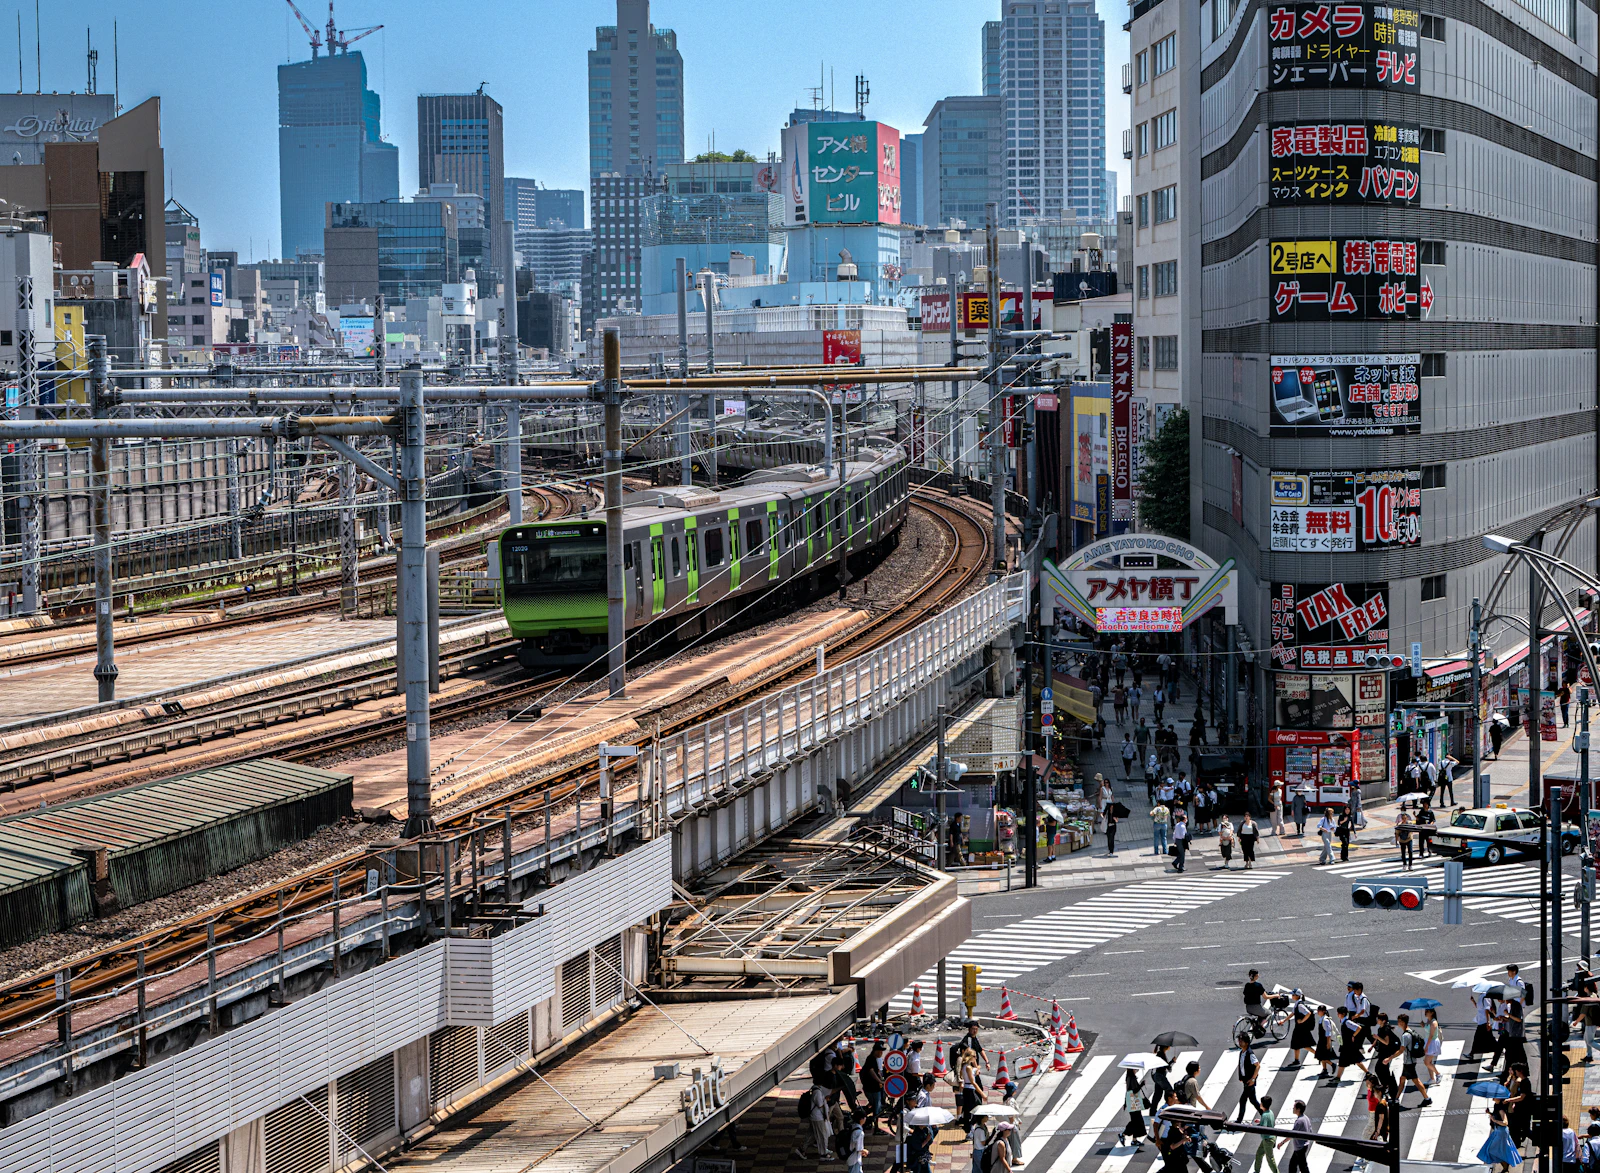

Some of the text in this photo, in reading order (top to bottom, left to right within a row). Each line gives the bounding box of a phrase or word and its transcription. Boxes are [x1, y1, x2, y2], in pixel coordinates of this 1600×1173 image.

[1270, 5, 1364, 40] カメラ
[1394, 8, 1418, 27] 修理受付
[1374, 22, 1396, 44] 時計
[1307, 44, 1370, 59] ドライヤー
[1273, 60, 1366, 84] シェーバー
[1376, 50, 1416, 85] テレビ
[1272, 125, 1368, 158] 家電製品
[1374, 125, 1397, 142] 冷蔵庫
[817, 134, 868, 154] アメ横
[1374, 146, 1401, 160] エアコン
[812, 166, 874, 183] センター
[1272, 165, 1349, 182] スーツケース
[1358, 164, 1419, 200] パソコン
[1272, 186, 1301, 198] マウス
[1305, 182, 1348, 198] インク
[826, 193, 860, 212] ビル
[1273, 245, 1332, 272] 2号店へ
[1344, 240, 1417, 276] 携帯電話
[1274, 281, 1358, 314] ゲーム
[1379, 282, 1417, 314] ホビー
[922, 301, 950, 324] サンドラッグ
[971, 301, 988, 320] 薬
[1114, 334, 1130, 403] カラオケ
[1354, 365, 1416, 382] ネットで注文
[1348, 383, 1419, 403] 店舗で受け取り
[1116, 426, 1128, 488] BIG ECHO
[1279, 482, 1296, 490] GOLD
[1272, 510, 1300, 522] 入会金
[1306, 510, 1352, 534] 無料
[1356, 484, 1393, 543] 10
[1272, 522, 1300, 534] 年会費
[1083, 538, 1195, 563] AMEYAYOKOCHO
[1272, 537, 1353, 548] 店頭にてすぐ発行
[1087, 577, 1199, 601] アメヤ横丁
[1116, 610, 1182, 621] 古き良き時代
[1282, 584, 1294, 640] ヨドバシ
[1296, 583, 1356, 631] TAX
[1338, 592, 1388, 642] FREE
[1272, 598, 1282, 640] カメラ
[1368, 629, 1388, 641] STORE
[1337, 706, 1351, 714] VISA
[1277, 734, 1296, 742] Coca-Cola
[890, 1057, 902, 1066] 30
